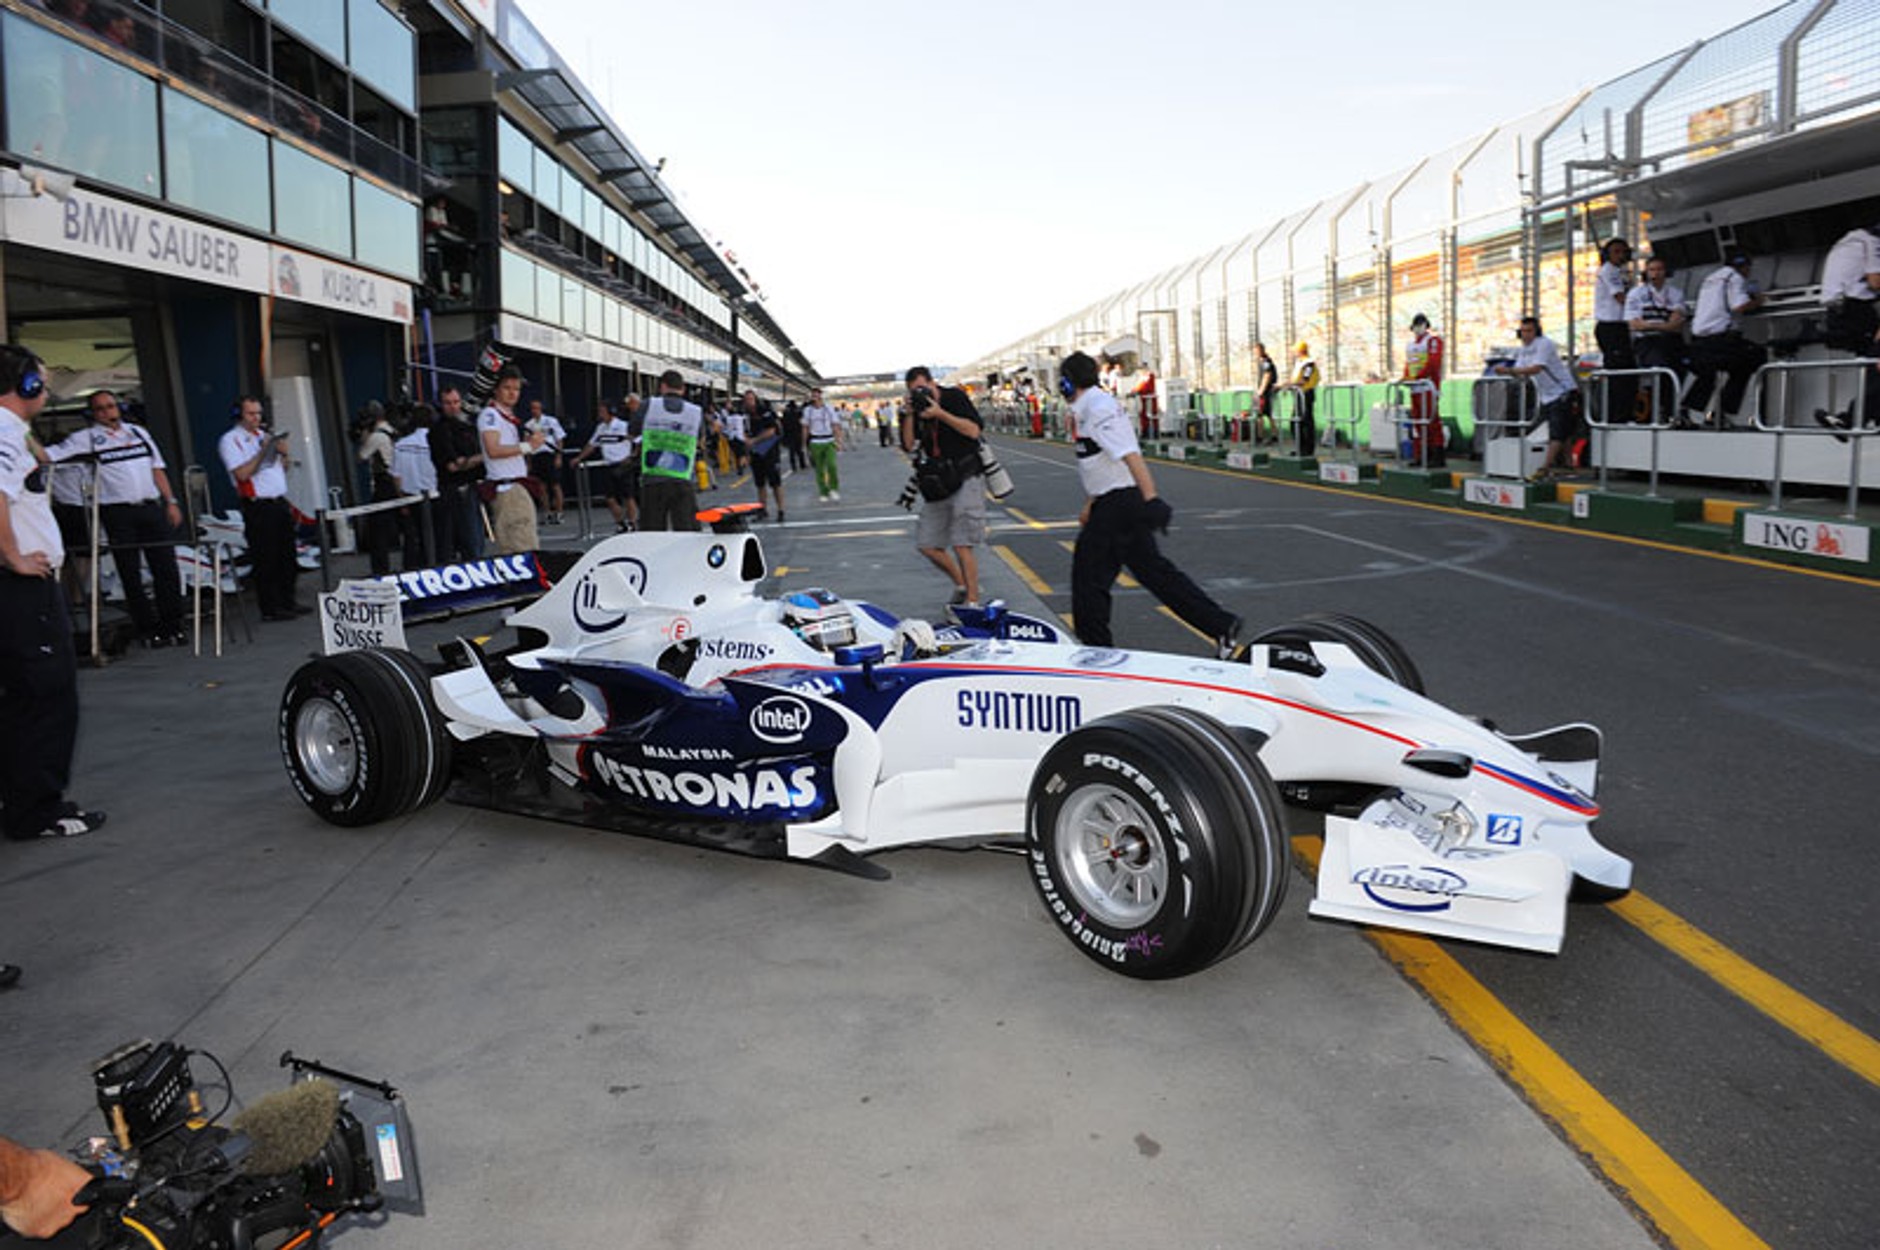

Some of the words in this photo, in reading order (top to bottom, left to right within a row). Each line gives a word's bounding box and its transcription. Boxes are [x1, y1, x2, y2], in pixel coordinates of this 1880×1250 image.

[63, 197, 140, 253] BMW
[148, 219, 240, 277] SAUBER
[322, 267, 377, 309] KUBICA
[1763, 522, 1809, 551] ING
[373, 554, 534, 600] ETRONAS
[325, 597, 387, 629] CREDIT
[333, 622, 384, 649] SUISSE
[1009, 625, 1046, 639] DELL
[757, 705, 802, 731] intel
[958, 690, 1081, 734] SYNTIUM
[642, 744, 734, 760] MALAYSIA
[592, 750, 818, 810] PETRONAS
[1083, 753, 1191, 863] POTENZA
[1369, 867, 1450, 894] intel
